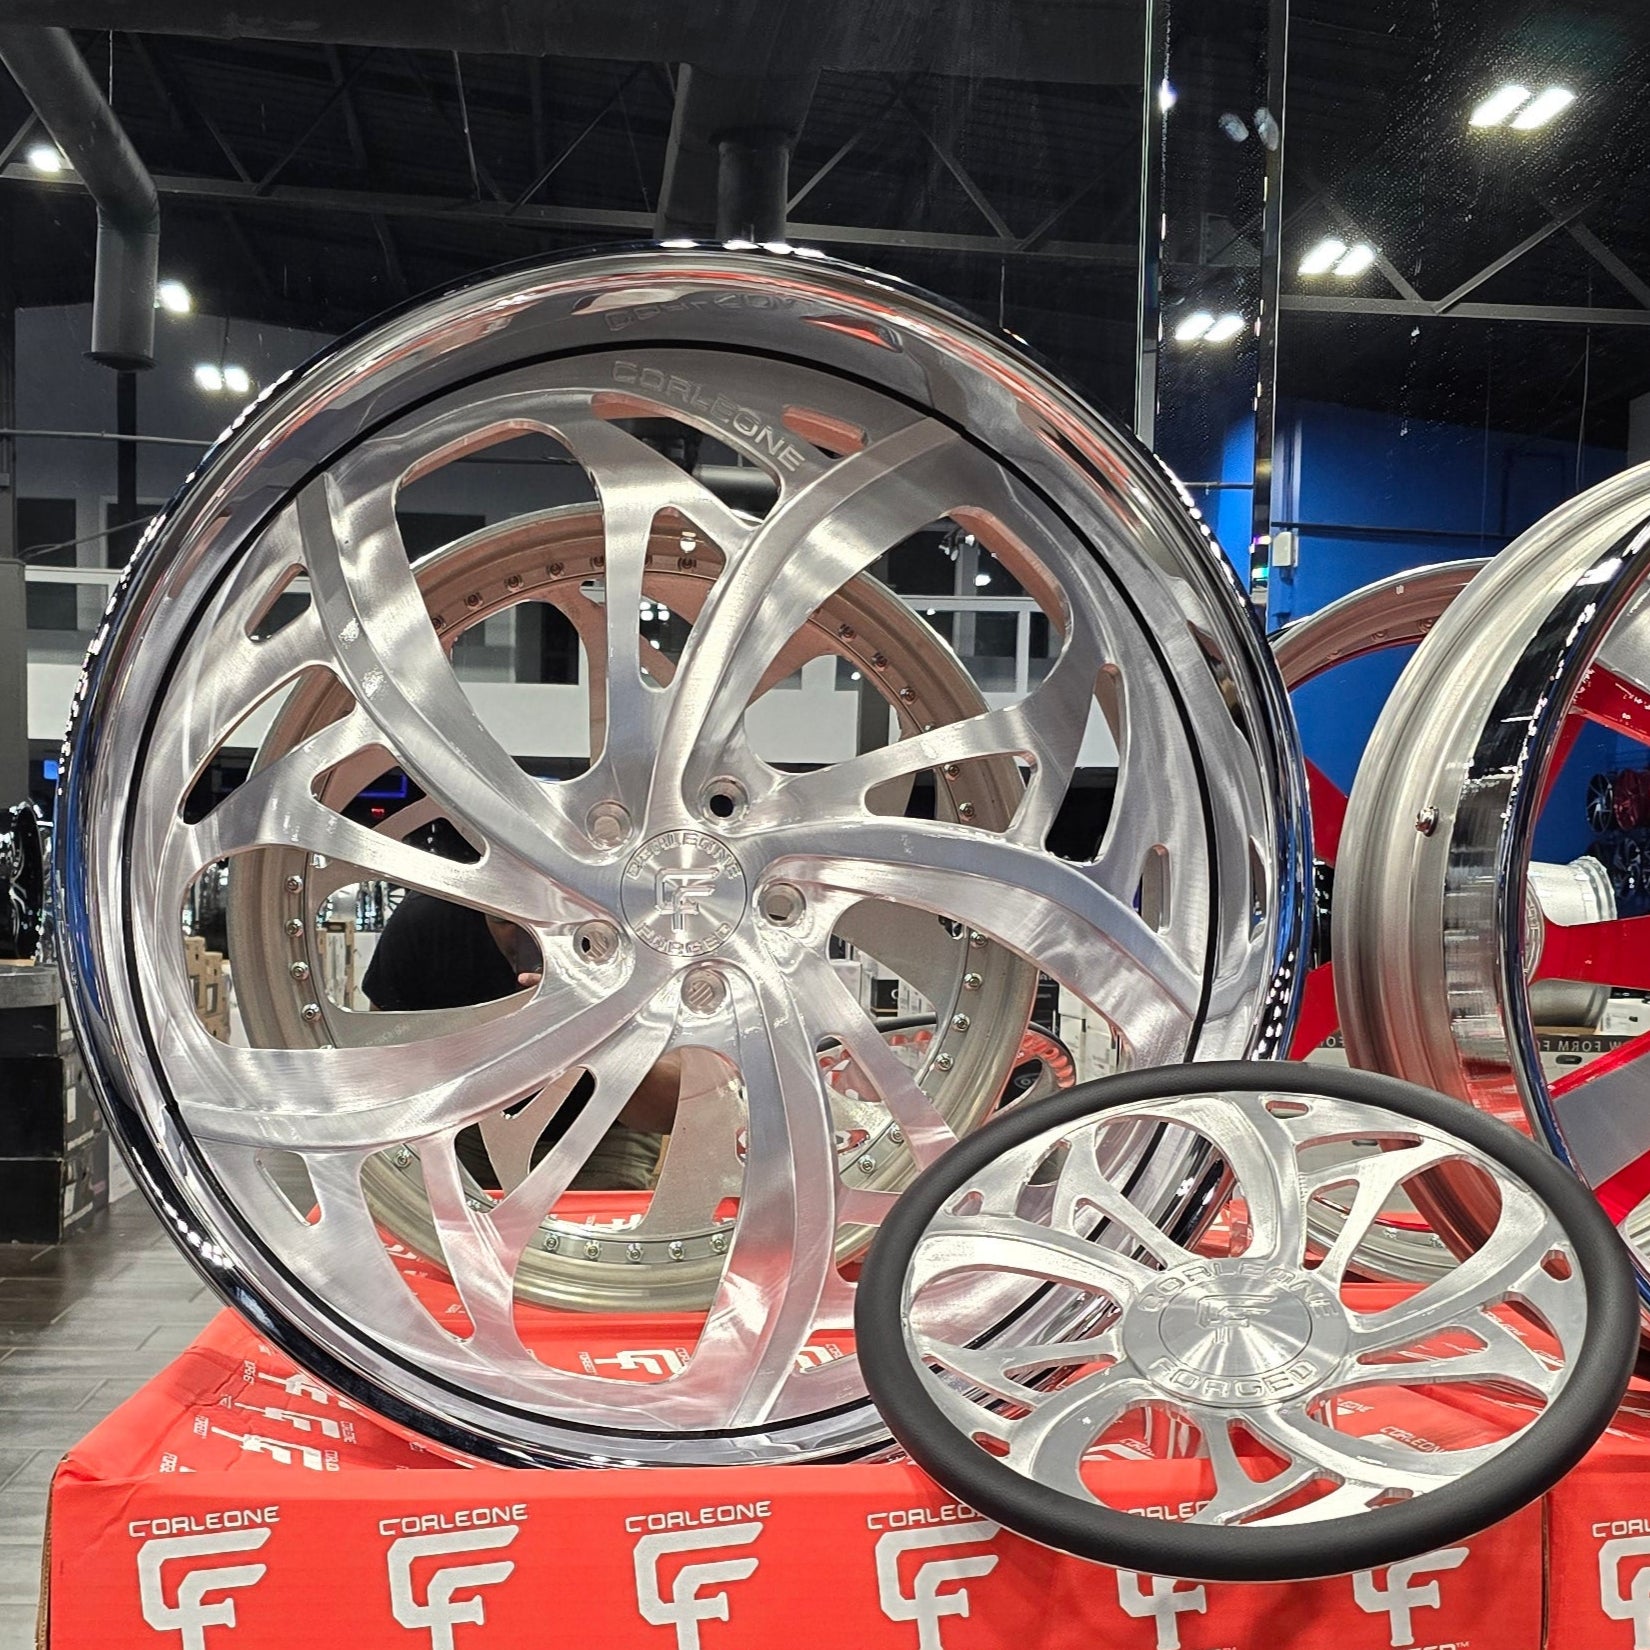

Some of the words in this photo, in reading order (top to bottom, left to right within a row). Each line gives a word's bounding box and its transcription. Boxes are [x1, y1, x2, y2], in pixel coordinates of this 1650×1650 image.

[612, 360, 806, 471] CORLEONE
[1137, 1262, 1339, 1320] CORLEONE
[1147, 1356, 1318, 1399] FORGED
[1379, 1425, 1446, 1453] CORLEON
[128, 1505, 281, 1538] CORLEONE
[378, 1503, 529, 1536] CORLEONE
[624, 1500, 773, 1533] CORLEONE
[866, 1503, 984, 1530] CORLEO
